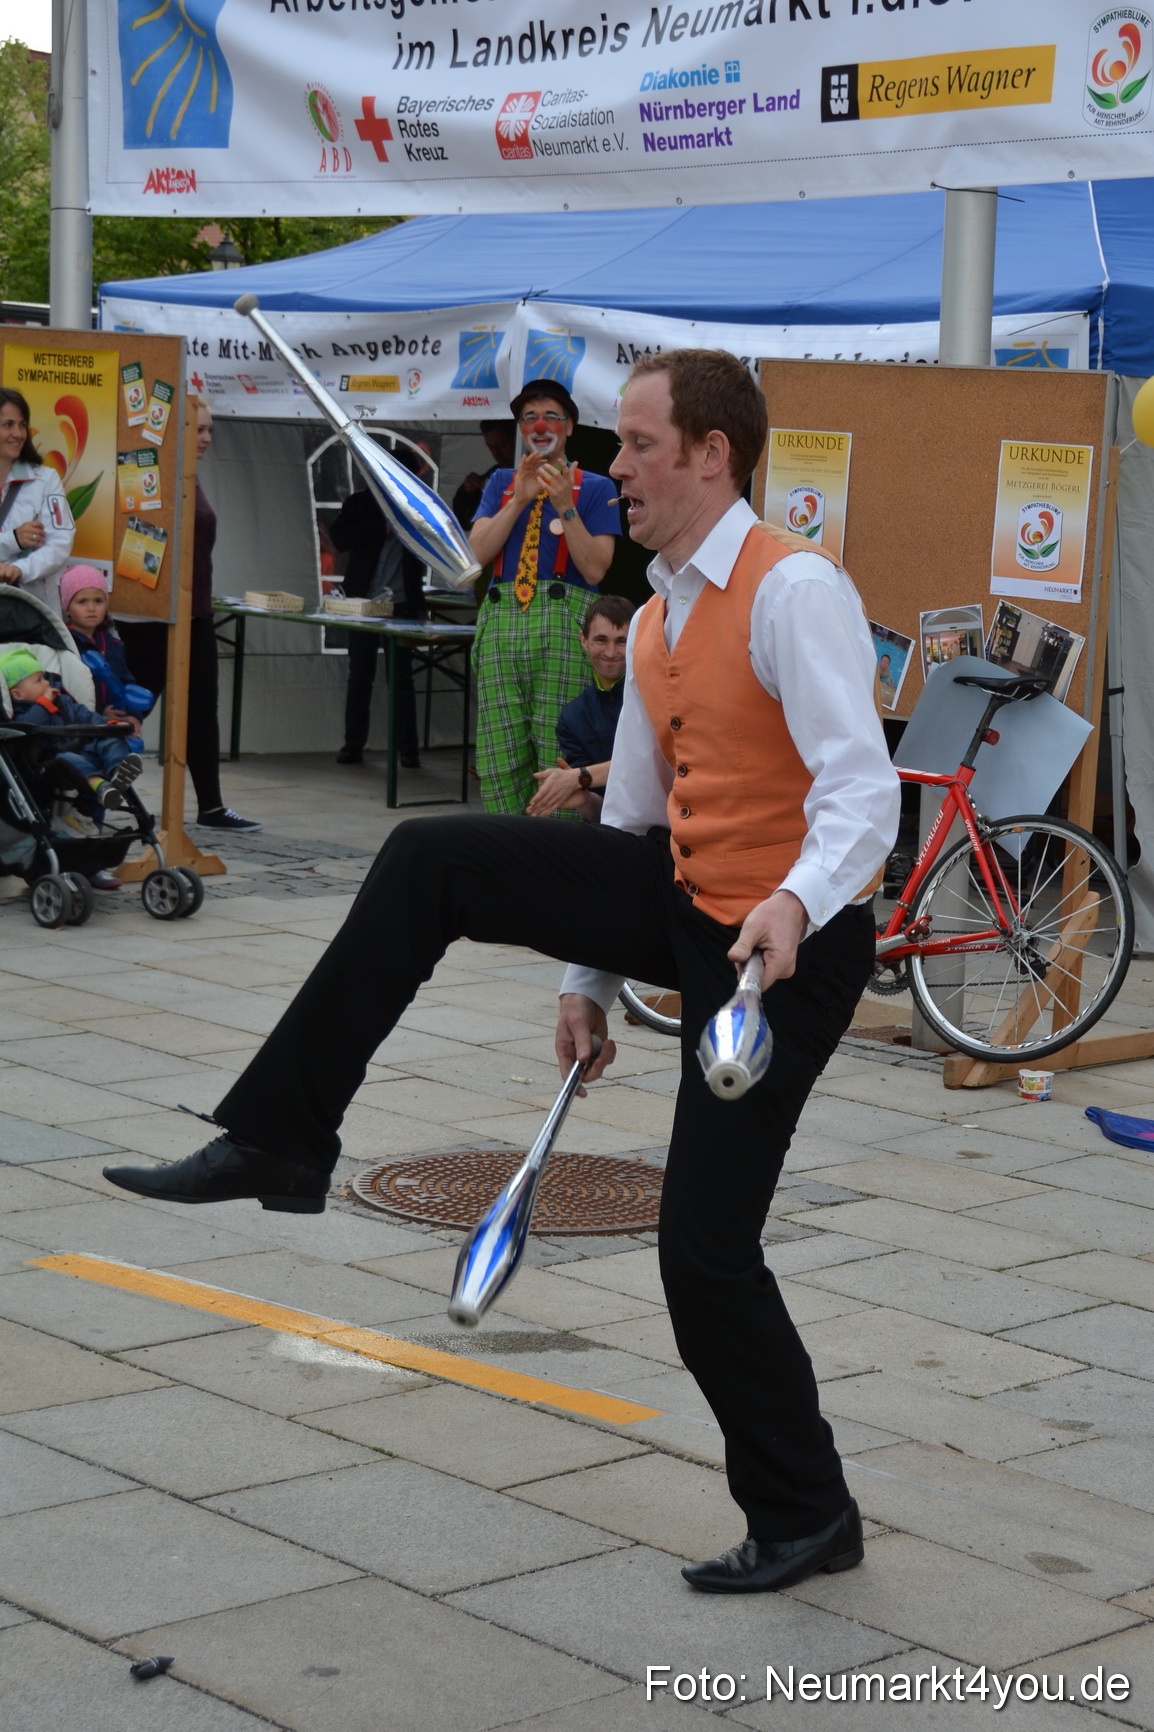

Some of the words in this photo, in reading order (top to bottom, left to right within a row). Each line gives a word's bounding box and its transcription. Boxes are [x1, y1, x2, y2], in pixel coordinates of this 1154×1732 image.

[1093, 10, 1151, 34] SYMPATHIEBLUME
[392, 32, 435, 70] im
[449, 13, 630, 69] Landkreis
[639, 63, 720, 92] Diakonie
[867, 74, 940, 109] Regens
[947, 64, 1037, 100] Wagner
[397, 95, 495, 117] Bayerisches
[541, 88, 588, 107] Caritas-
[639, 98, 746, 121] Nürnberger
[752, 88, 801, 113] Land
[531, 109, 614, 131] Sozialstation
[1087, 103, 1097, 114] FÜR
[1095, 110, 1127, 121] MENSCHEN
[1094, 117, 1105, 127] MIT
[1105, 109, 1145, 127] BEHINDERUNG
[397, 119, 439, 139] Rotes
[643, 126, 733, 152] Neumarkt
[404, 143, 449, 162] Kreuz
[502, 145, 531, 159] caritas
[532, 136, 600, 157] Neumarkt
[602, 132, 629, 152] e.V.
[331, 335, 442, 361] Angebote
[33, 352, 95, 369] WETTBEWERB
[18, 368, 103, 387] SYMPATHIEBLUME
[777, 434, 844, 451] URKUNDE
[1009, 446, 1085, 465] URKUNDE
[1022, 502, 1061, 516] SYMPATHIEBLUME
[1044, 586, 1073, 595] NEUMARKT
[915, 809, 944, 869] SPECIALIZED
